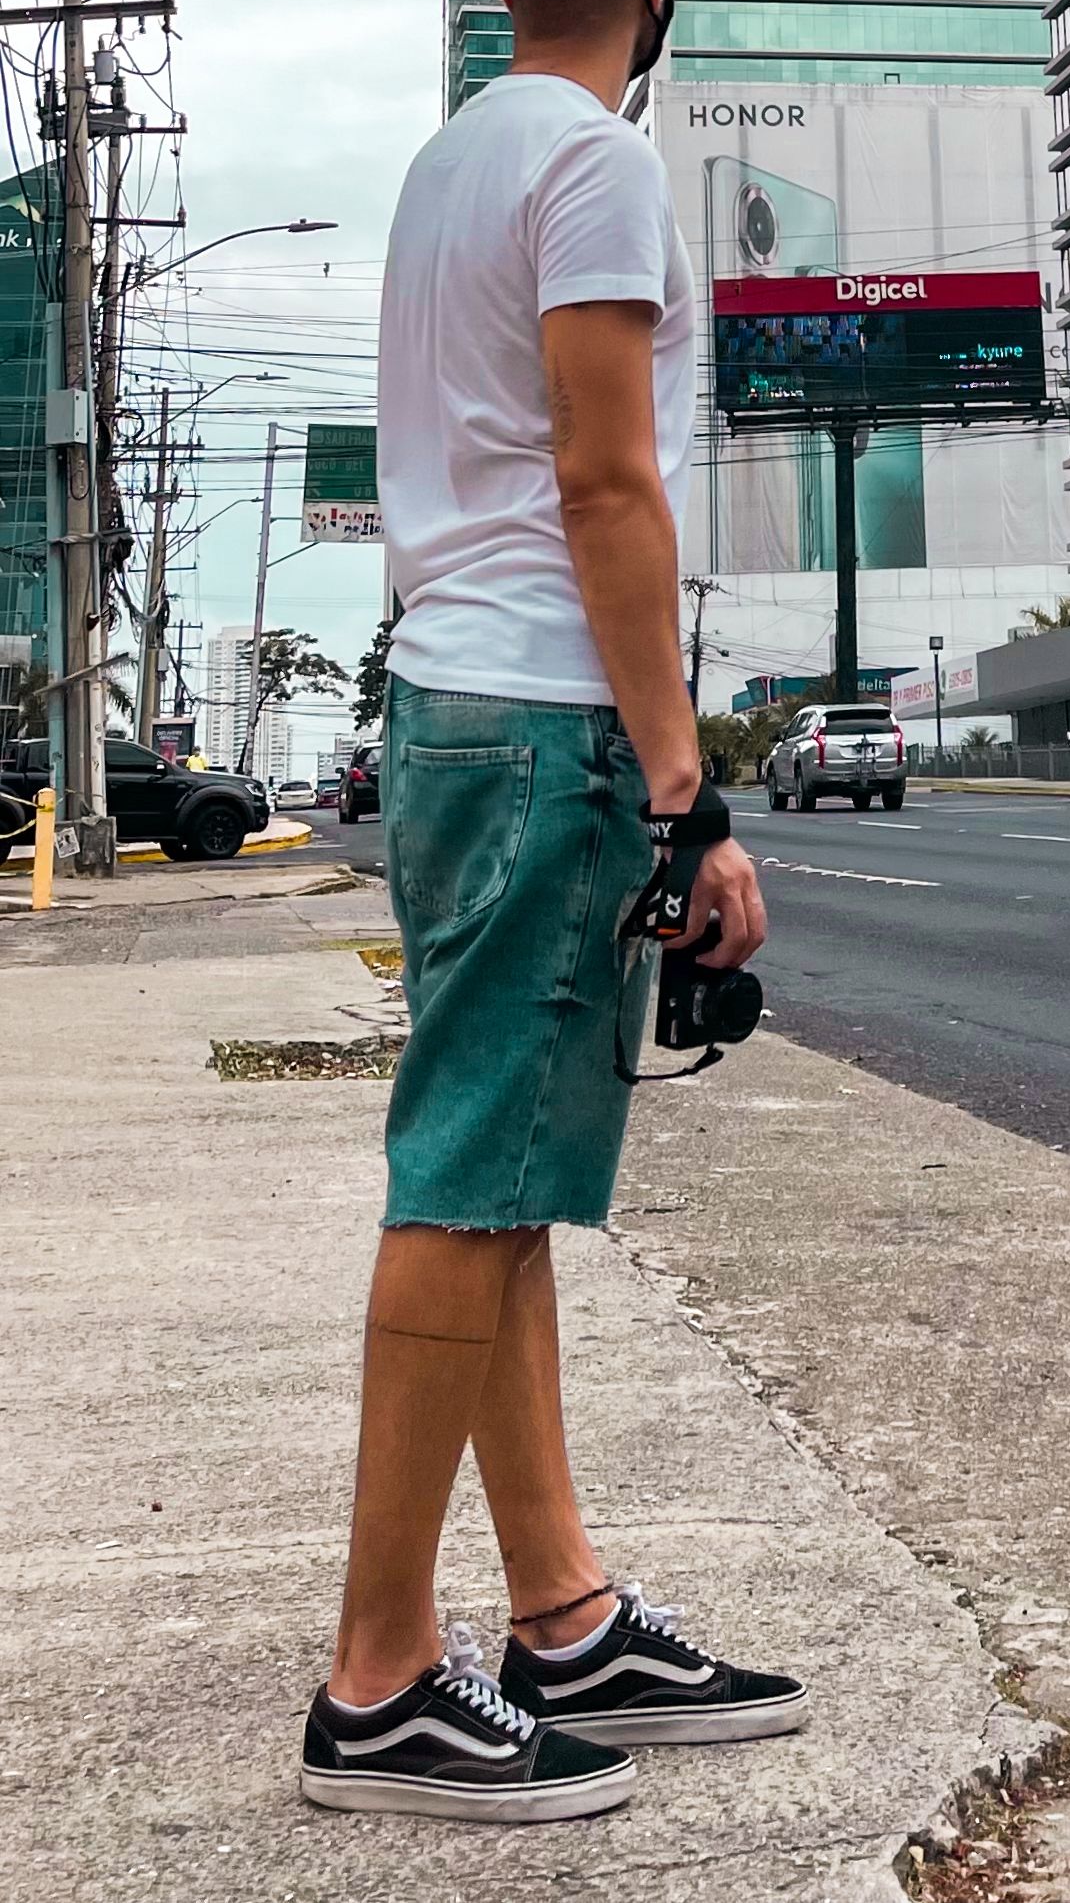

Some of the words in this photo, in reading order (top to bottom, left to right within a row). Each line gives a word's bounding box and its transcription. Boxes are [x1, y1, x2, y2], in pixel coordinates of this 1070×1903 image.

[690, 104, 806, 128] HONOR
[836, 275, 928, 306] Digicel
[857, 678, 890, 691] delta
